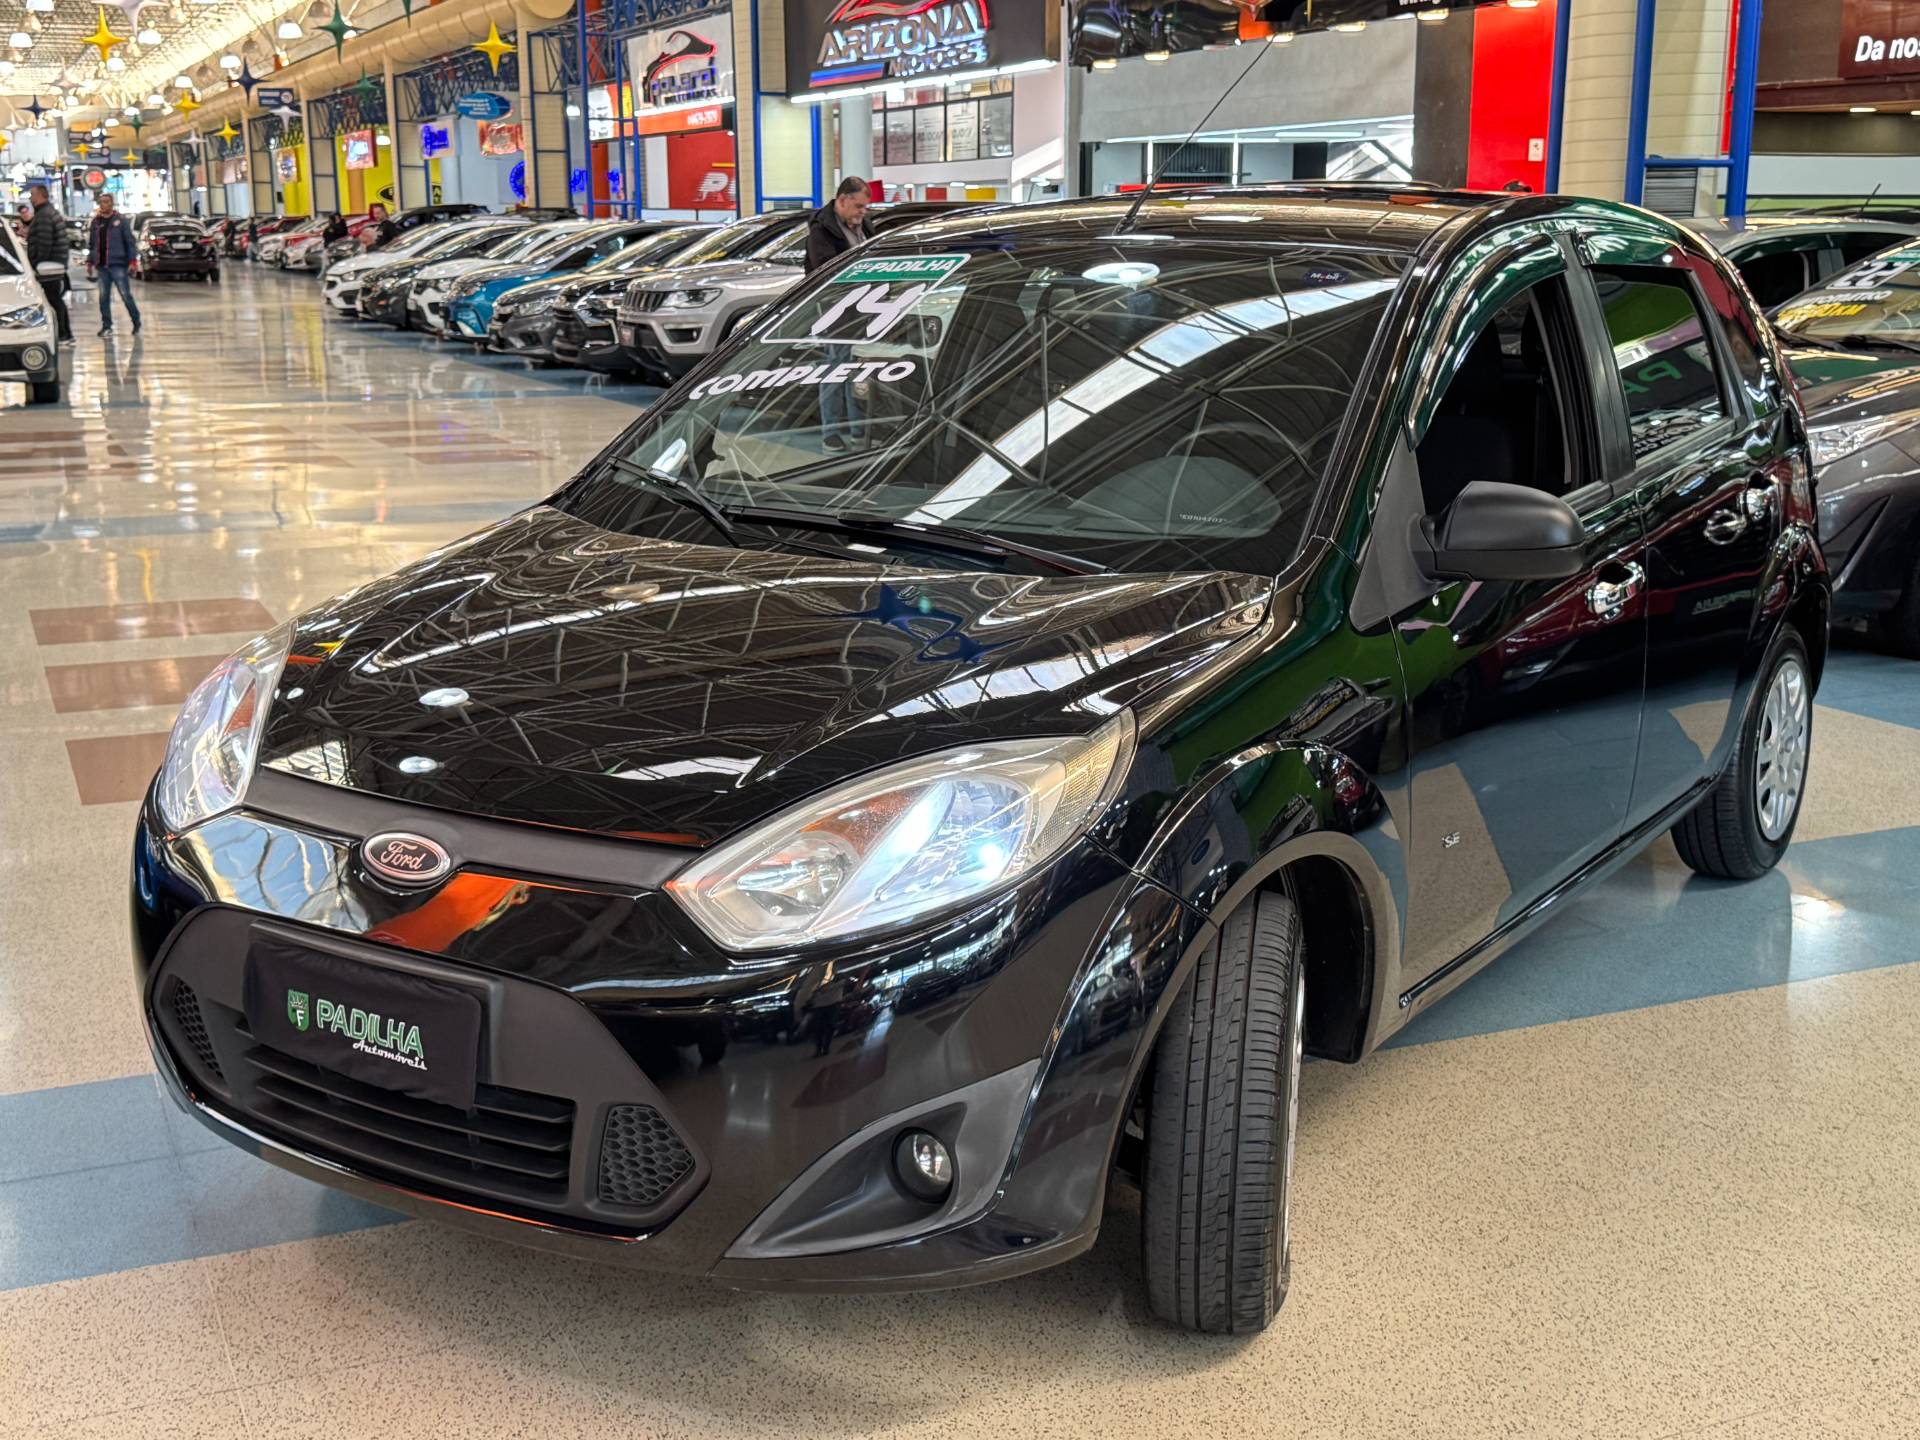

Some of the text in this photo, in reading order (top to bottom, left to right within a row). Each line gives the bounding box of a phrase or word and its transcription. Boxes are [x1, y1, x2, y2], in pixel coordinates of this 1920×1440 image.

[817, 3, 980, 66] ARIZONA
[1855, 35, 1920, 62] Da no
[866, 259, 956, 274] PADILHA
[1832, 261, 1911, 288] 22
[811, 283, 926, 338] 14
[689, 361, 916, 400] COMPLETO
[381, 841, 427, 869] Ford
[297, 1010, 305, 1026] F
[316, 999, 423, 1059] PADILHA
[353, 1040, 427, 1070] Automóveis
